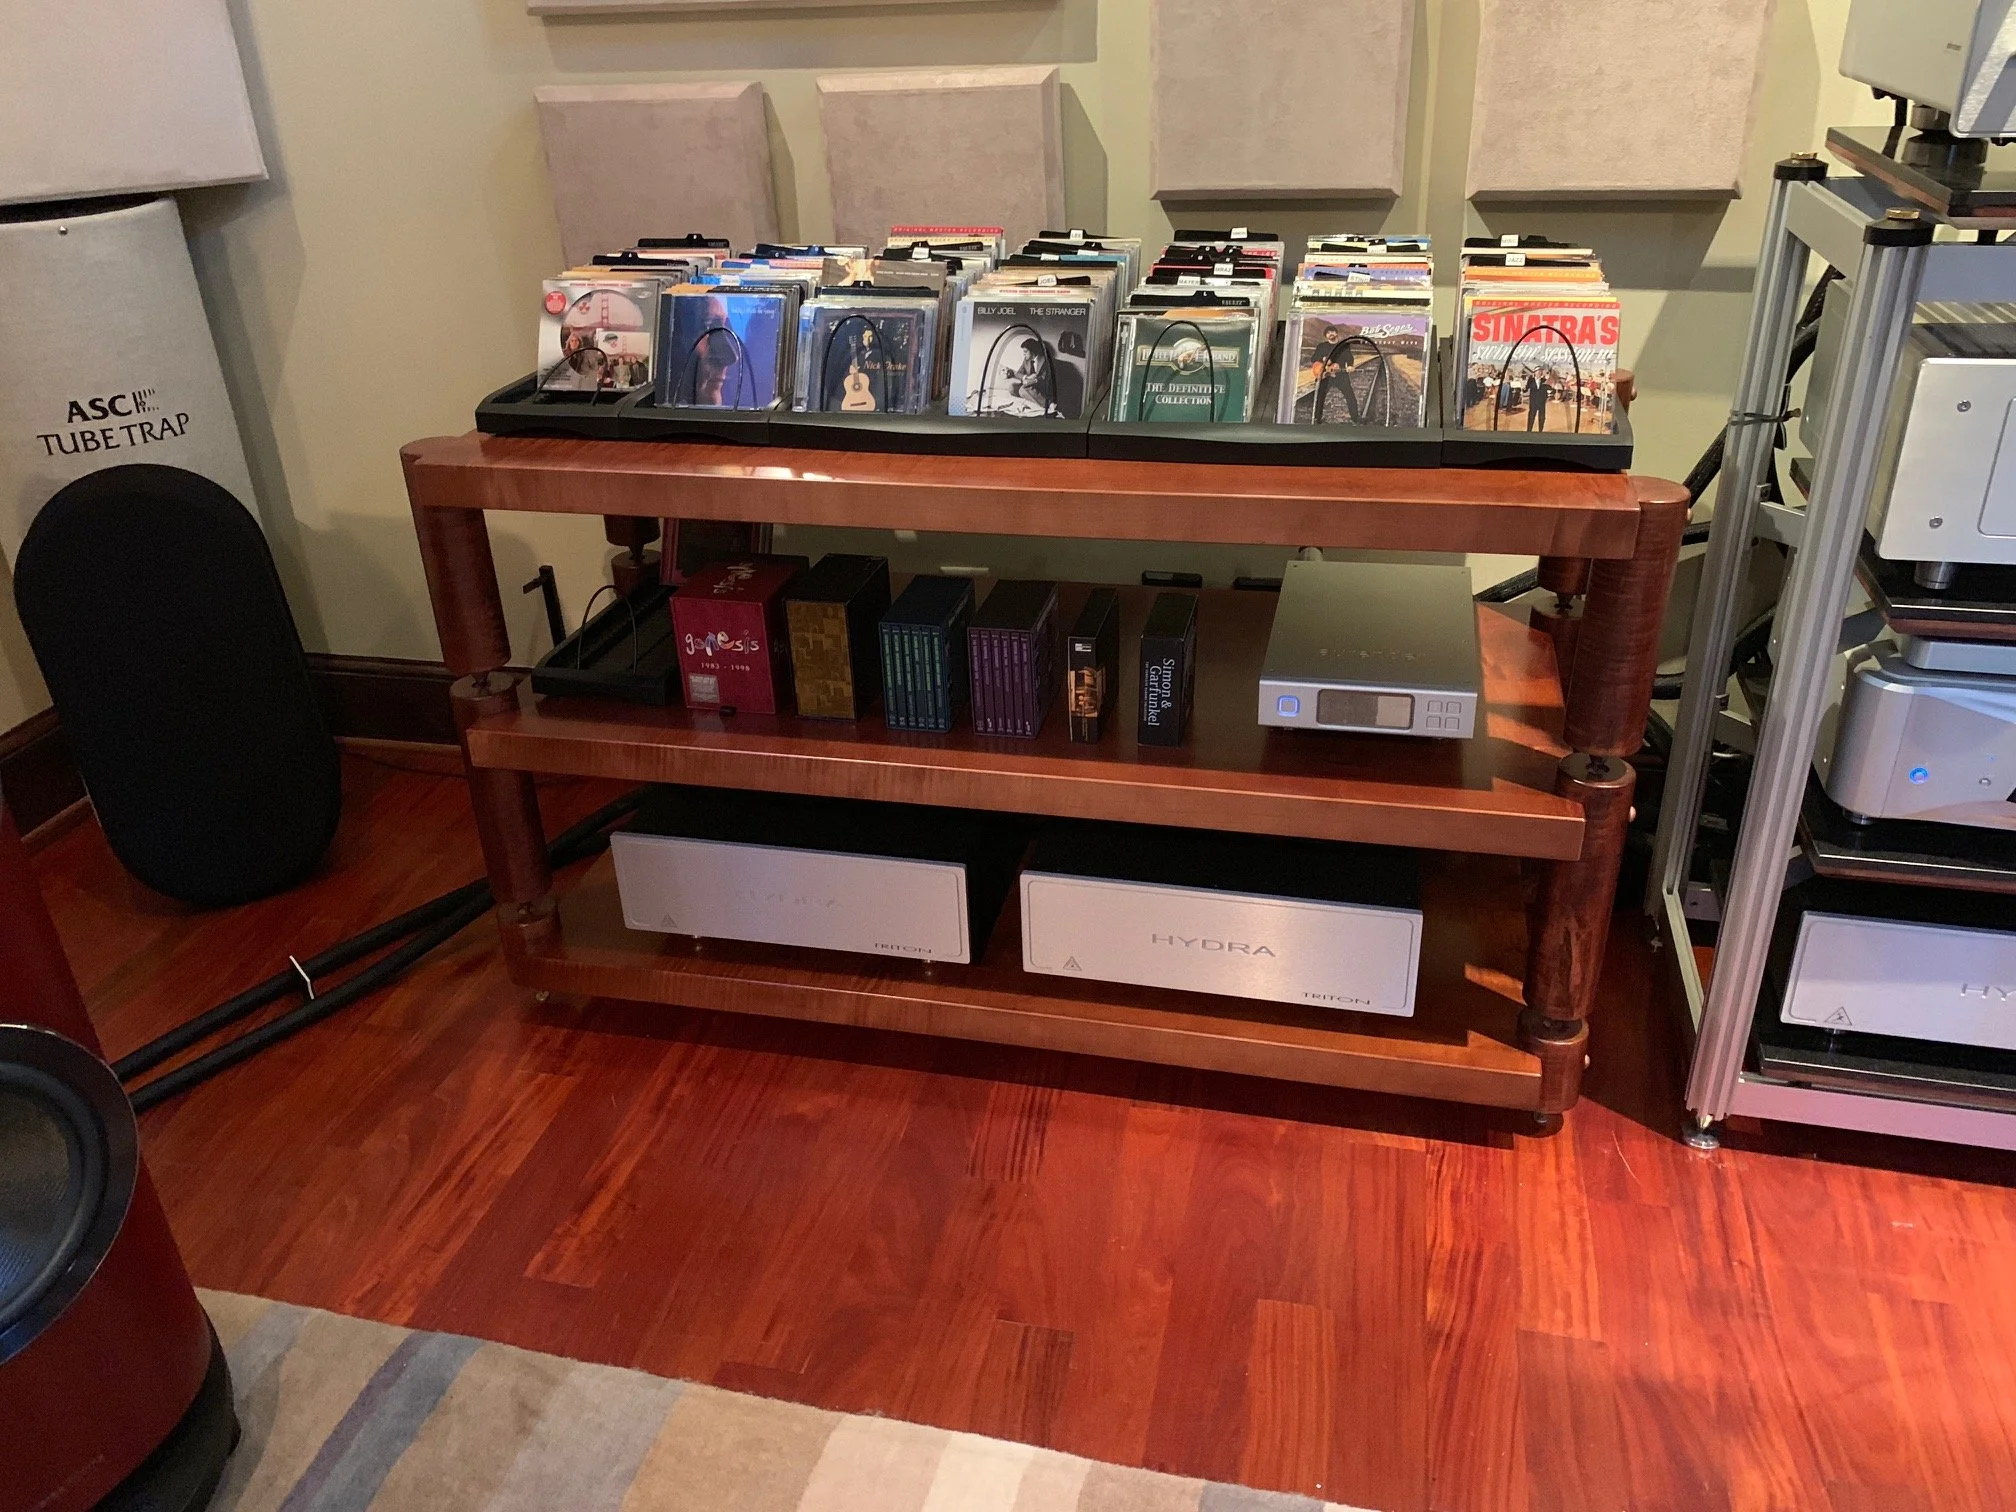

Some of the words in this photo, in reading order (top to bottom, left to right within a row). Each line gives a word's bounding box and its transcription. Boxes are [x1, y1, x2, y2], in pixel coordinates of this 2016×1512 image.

[977, 307, 997, 315] BILLY
[997, 308, 1016, 316] JOEL
[1029, 307, 1044, 316] THE
[1046, 307, 1087, 317] STRANGER
[1473, 313, 1619, 345] SINATRA'S
[863, 361, 881, 370] Nick
[1146, 383, 1165, 392] THE
[1168, 383, 1226, 394] DEFINITIVE
[1155, 394, 1212, 405] COLLECTION
[67, 394, 133, 424] ASC
[1162, 658, 1175, 698] Simon
[1147, 665, 1162, 727] Garfunkel
[1161, 700, 1172, 709] &
[1151, 933, 1276, 958] HYDRA
[1302, 992, 1371, 1006] TRITON
